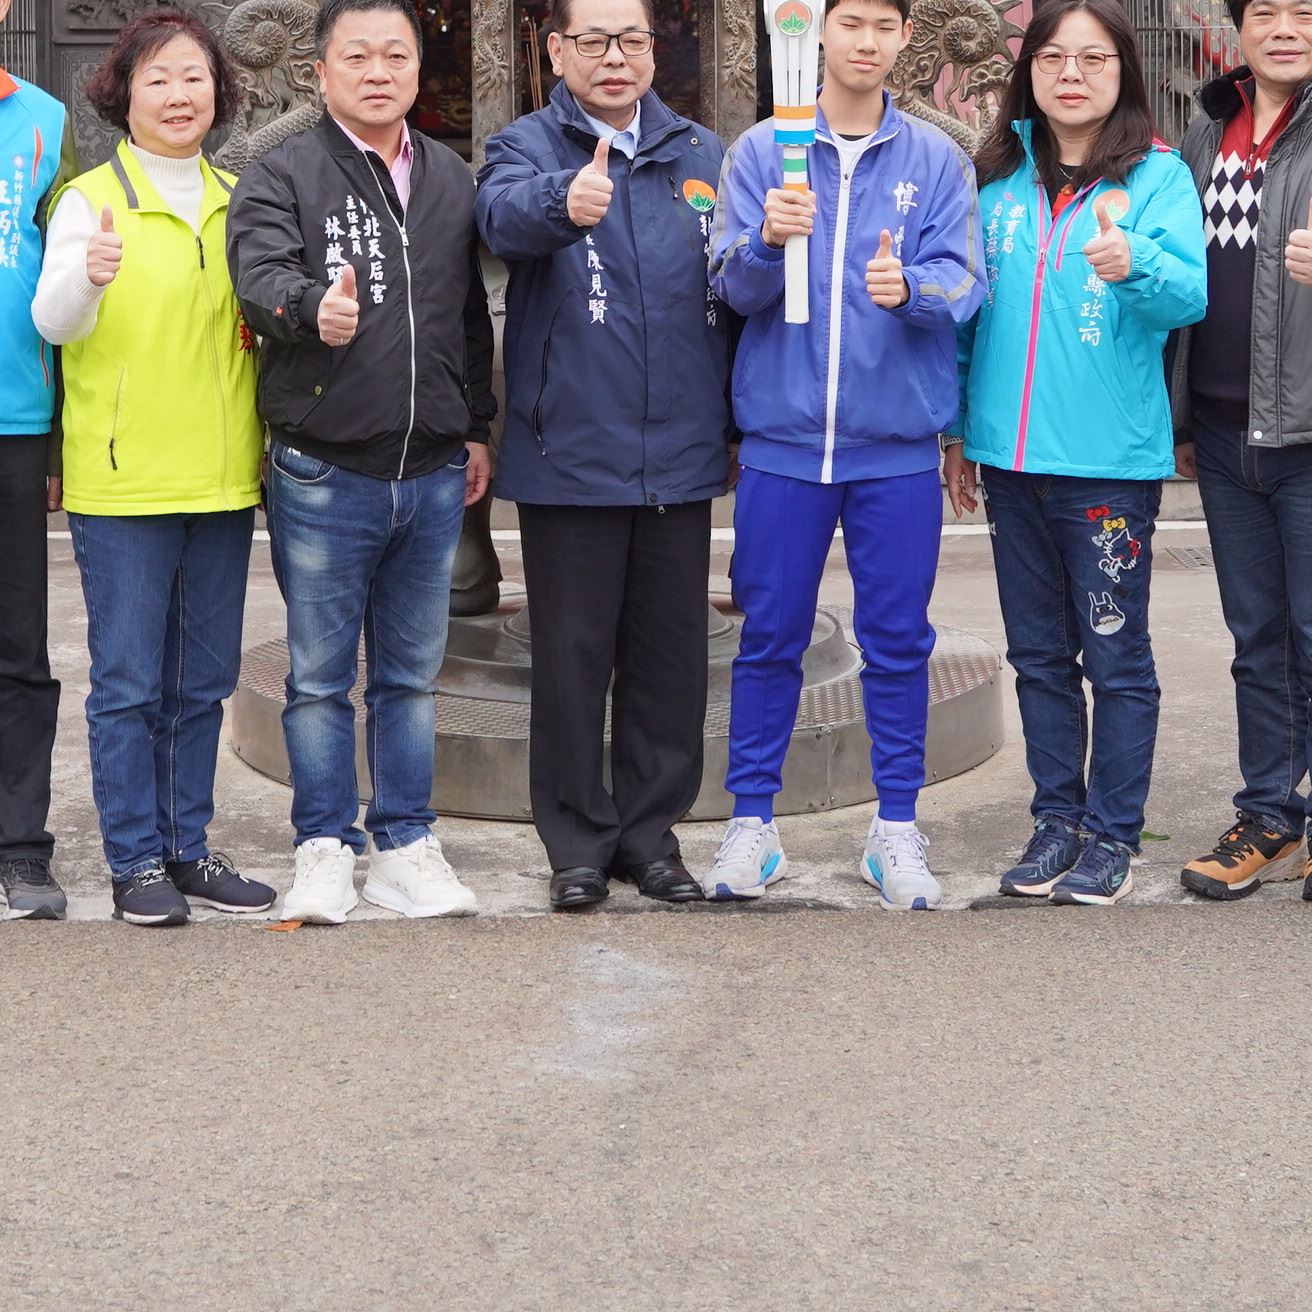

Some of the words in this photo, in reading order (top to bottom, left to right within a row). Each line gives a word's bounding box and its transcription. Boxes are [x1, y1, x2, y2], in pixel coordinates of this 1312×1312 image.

[346, 194, 363, 256] 主任委員
[1001, 202, 1026, 255] 教育局
